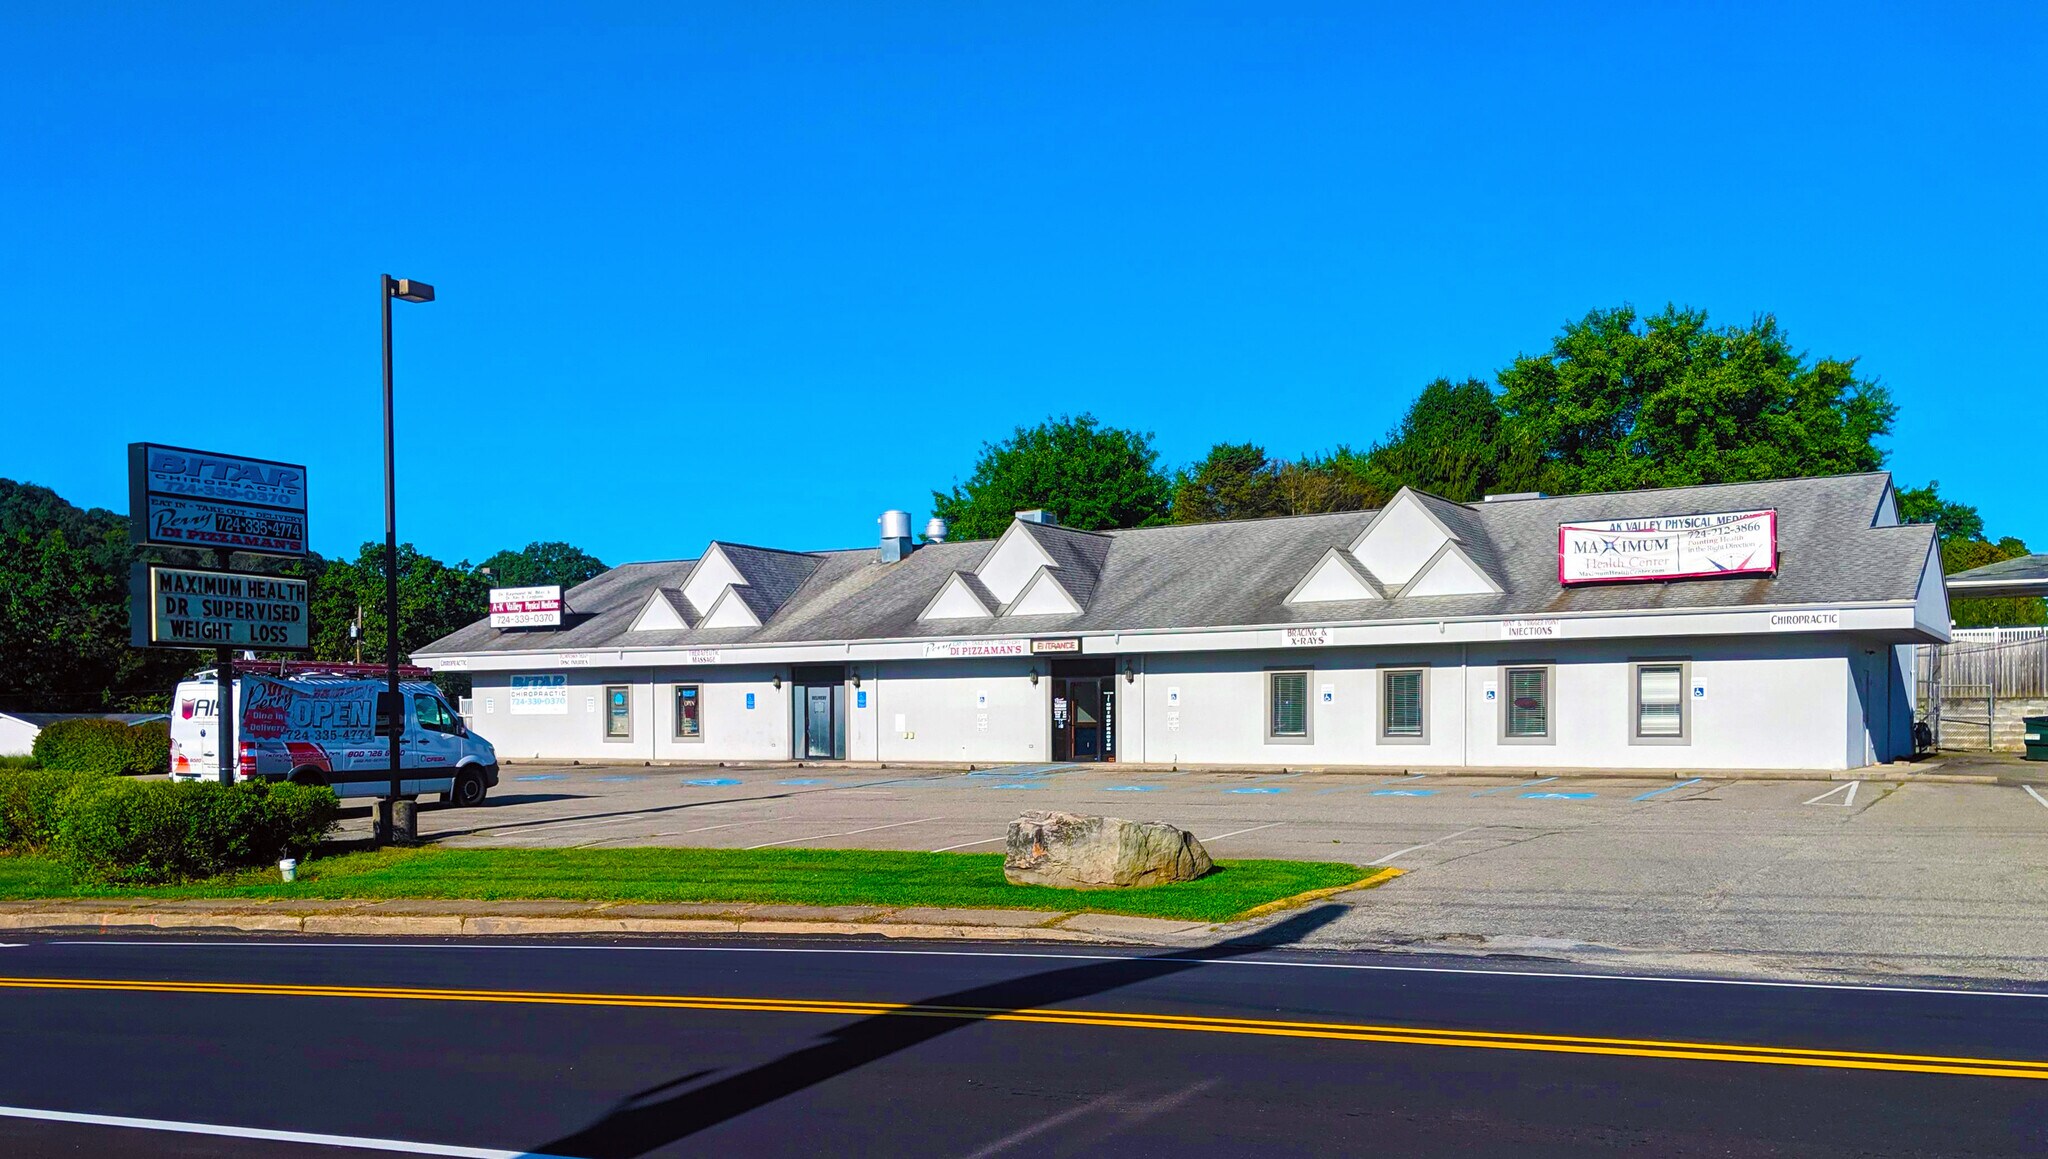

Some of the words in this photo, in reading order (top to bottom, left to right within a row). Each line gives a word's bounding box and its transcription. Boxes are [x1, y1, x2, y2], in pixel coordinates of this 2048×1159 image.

[150, 453, 300, 489] BITAR
[155, 474, 297, 495] CHIROPRACTIC
[163, 481, 291, 504] 724-339-0370
[151, 499, 173, 507] EAT
[196, 504, 225, 514] TAKE
[256, 511, 303, 523] DELIVERY
[152, 508, 213, 537] Perry
[1610, 523, 1623, 532] AK
[1626, 519, 1662, 531] VALLEY
[1665, 517, 1712, 530] PHYSICAL
[161, 527, 182, 538] DI
[186, 529, 302, 550] PIZZAMAN'S
[1687, 523, 1761, 539] 724-712-3866
[1720, 535, 1744, 543] Health
[1574, 536, 1669, 556] MAXIMUM
[1726, 542, 1755, 550] Direction
[1586, 557, 1624, 570] Health
[1629, 556, 1669, 567] Center
[159, 573, 242, 597] MAXIMUM
[248, 580, 305, 601] HEALTH
[166, 596, 189, 616] DR
[202, 599, 300, 622] SUPERVISED
[492, 603, 504, 612] A-K
[506, 602, 523, 613] Valley
[497, 614, 554, 624] 724-339-0370
[1771, 614, 1838, 625] CHIROPRACTIC
[170, 619, 233, 640] WEIGHT
[250, 624, 288, 643] LOSS
[1287, 628, 1317, 637] BRACING
[1321, 627, 1327, 636] &
[950, 647, 959, 655] DI
[962, 645, 1022, 655] PIZZAMAN'S
[1037, 642, 1076, 650] ENTRANCE
[512, 675, 567, 690] BITAR
[243, 683, 293, 719] Perry
[293, 701, 372, 728] OPEN
[250, 723, 286, 733] Delivery
